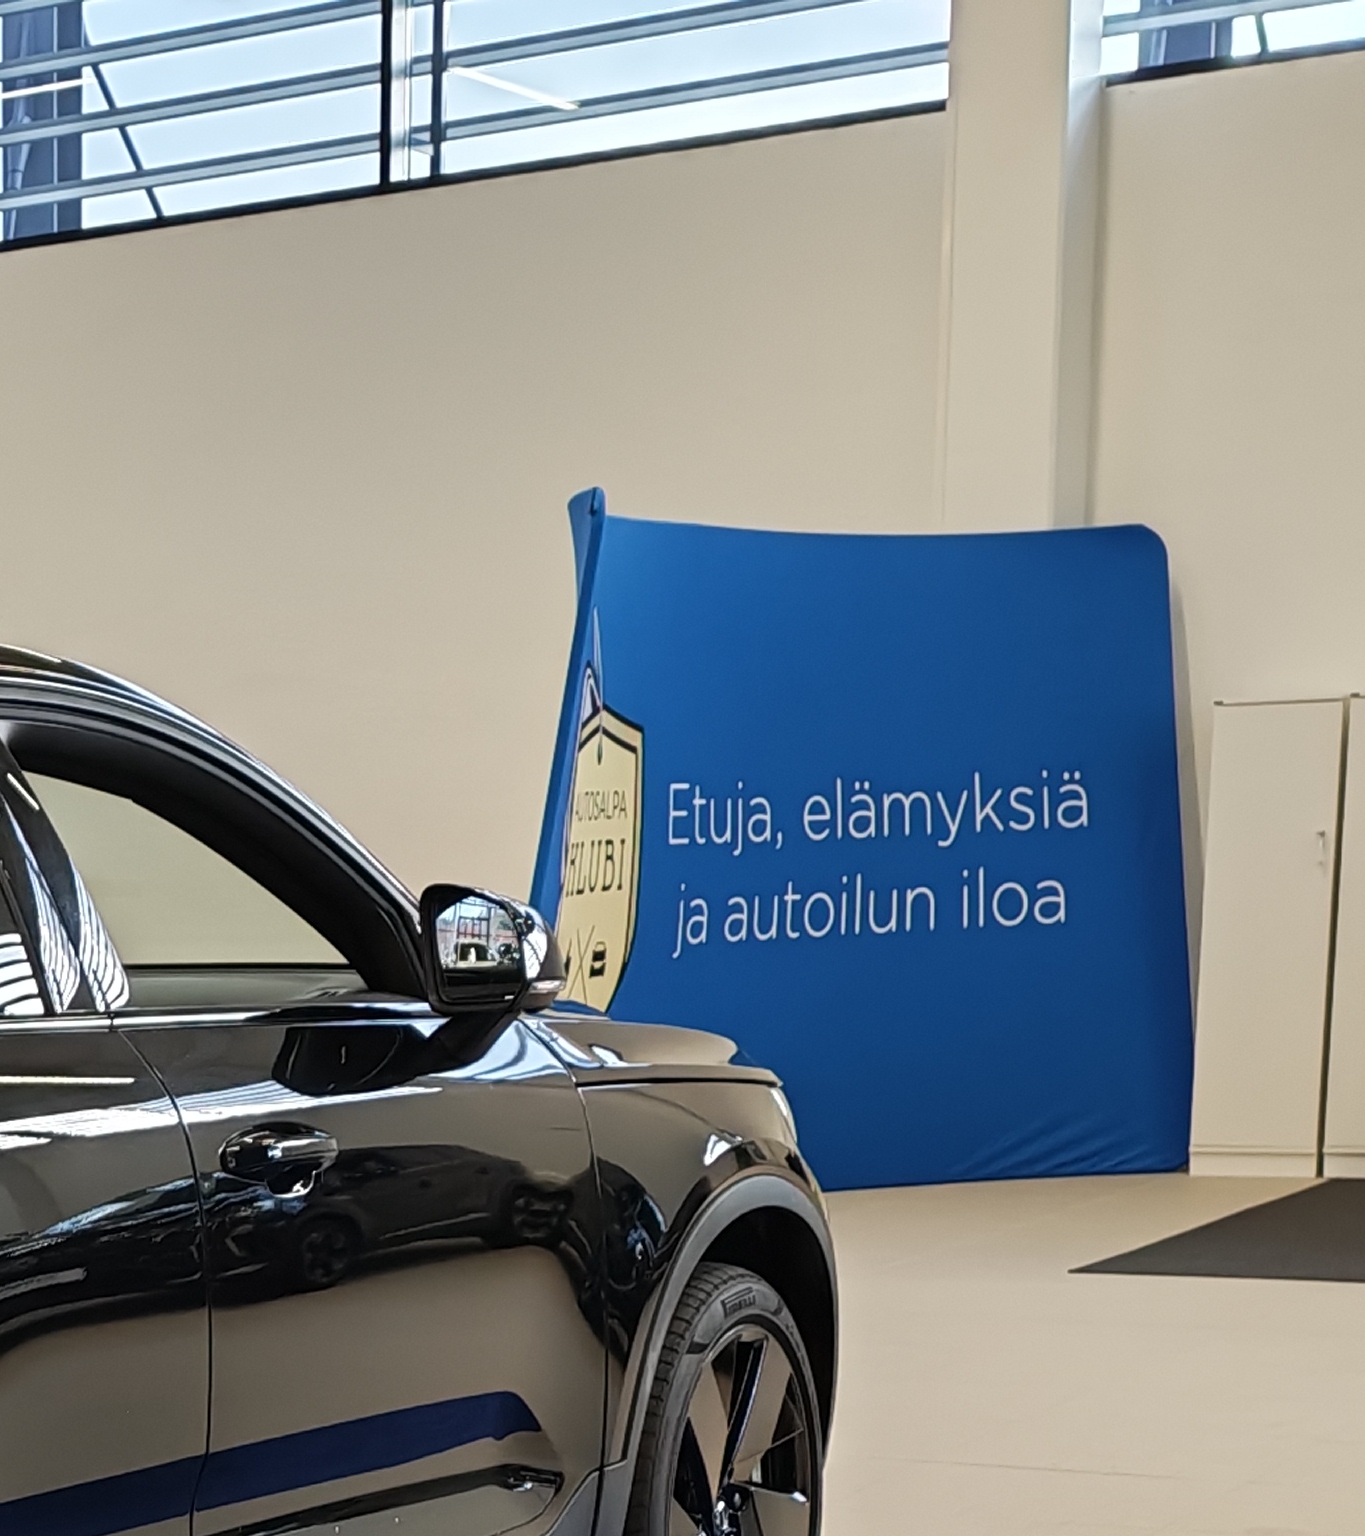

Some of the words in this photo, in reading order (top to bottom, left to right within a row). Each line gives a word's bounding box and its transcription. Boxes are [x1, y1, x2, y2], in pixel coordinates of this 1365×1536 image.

[667, 779, 784, 857] Etuja,
[802, 769, 1090, 848] elämyksiä
[565, 838, 626, 898] KLUBI
[672, 882, 708, 959] ja
[723, 872, 936, 944] autoilun
[961, 865, 1067, 930] iloa
